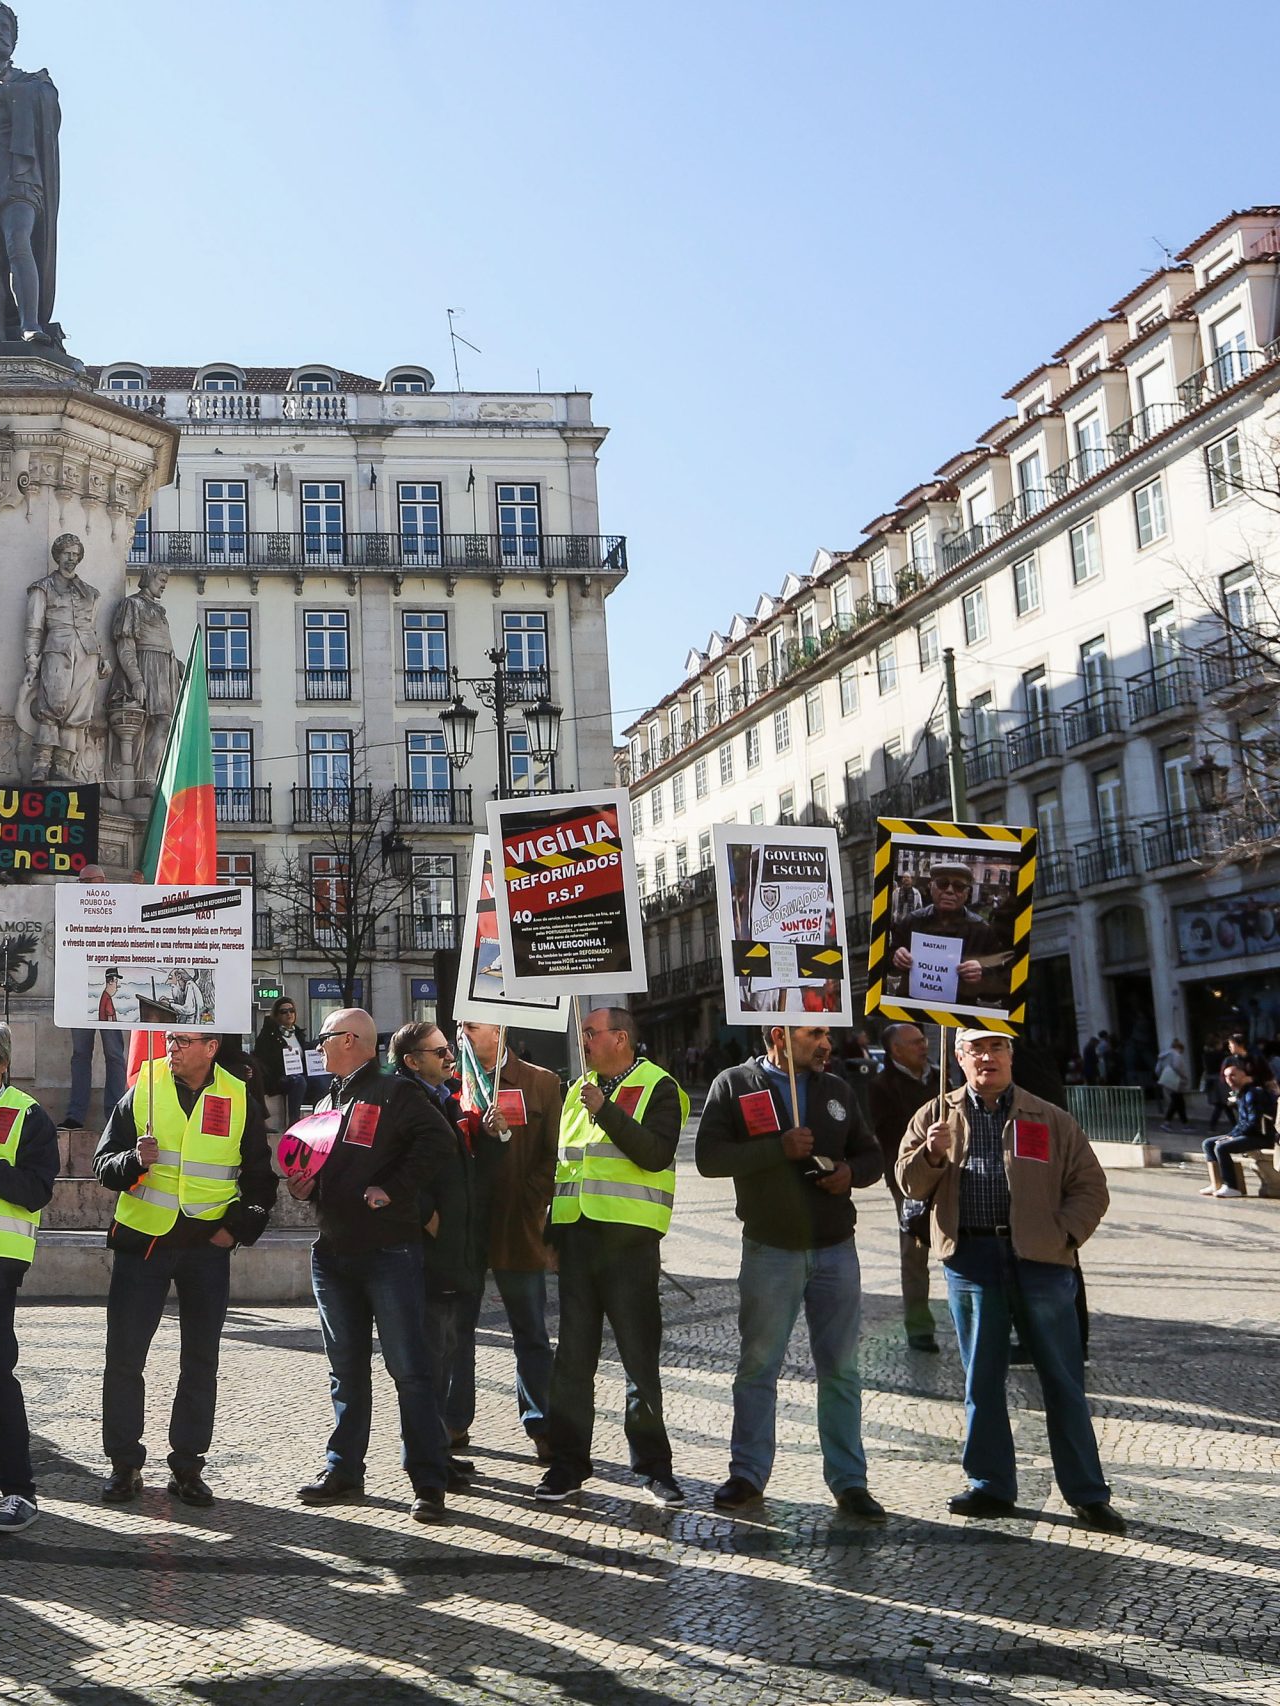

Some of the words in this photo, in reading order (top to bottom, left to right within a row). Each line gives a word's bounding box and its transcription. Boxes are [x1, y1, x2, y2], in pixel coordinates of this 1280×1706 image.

[506, 820, 616, 865] VIGÍLIA
[765, 850, 824, 862] GOVERNO
[510, 853, 619, 892] REFORMADOS
[773, 865, 821, 876] ESCUTA
[86, 889, 99, 897] NÃO
[548, 884, 585, 904] P.S.P
[753, 884, 825, 935] REFORMADOS
[512, 910, 532, 924] 40
[780, 916, 822, 932] JUNTOS!
[70, 924, 83, 932] Devia
[85, 925, 109, 933] mandar-te
[111, 926, 122, 935] para
[178, 926, 190, 934] foste
[220, 926, 242, 937] Portugal
[802, 932, 820, 942] LUTA
[67, 939, 84, 947] viveste
[173, 940, 192, 949] reforma
[194, 941, 208, 949] ainda
[209, 941, 220, 951] pior,
[531, 941, 536, 951] É
[538, 941, 555, 950] UMA
[556, 938, 601, 949] VERGONHA
[95, 955, 108, 963] agora
[110, 954, 131, 963] algumas
[132, 954, 155, 962] benesses
[163, 955, 173, 963] vais
[174, 957, 186, 965] para
[918, 962, 933, 970] SOU
[935, 965, 948, 973] UM
[920, 981, 943, 992] RASCA
